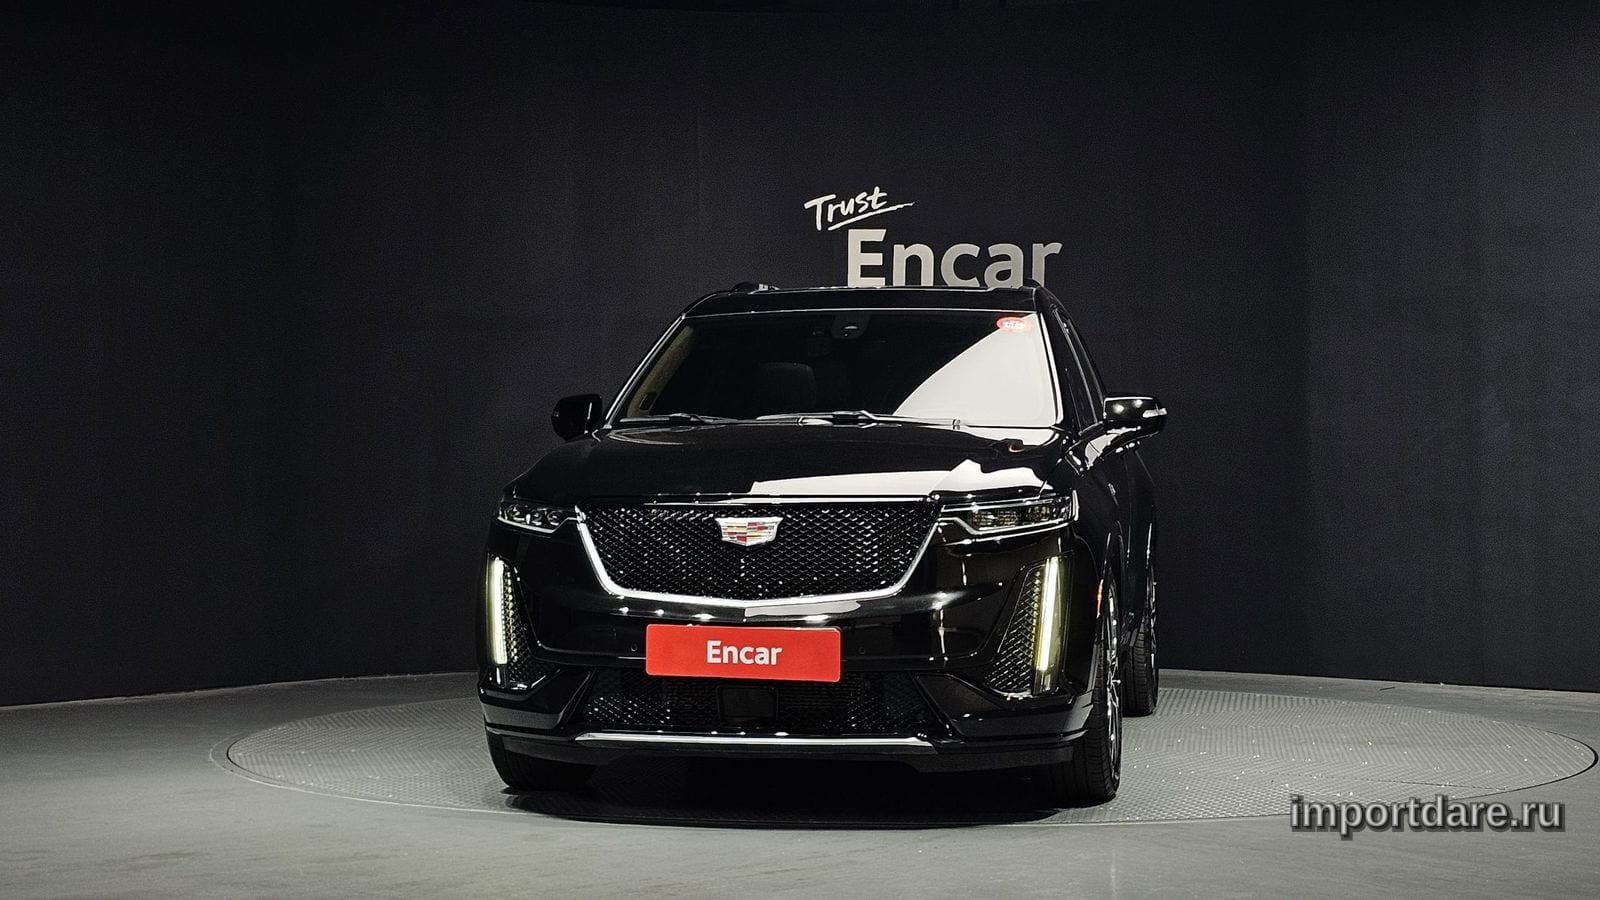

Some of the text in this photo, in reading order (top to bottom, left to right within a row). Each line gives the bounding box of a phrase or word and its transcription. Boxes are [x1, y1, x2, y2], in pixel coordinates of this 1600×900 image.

[804, 186, 889, 231] Trust
[847, 228, 1063, 289] Encar
[706, 639, 783, 665] Encar
